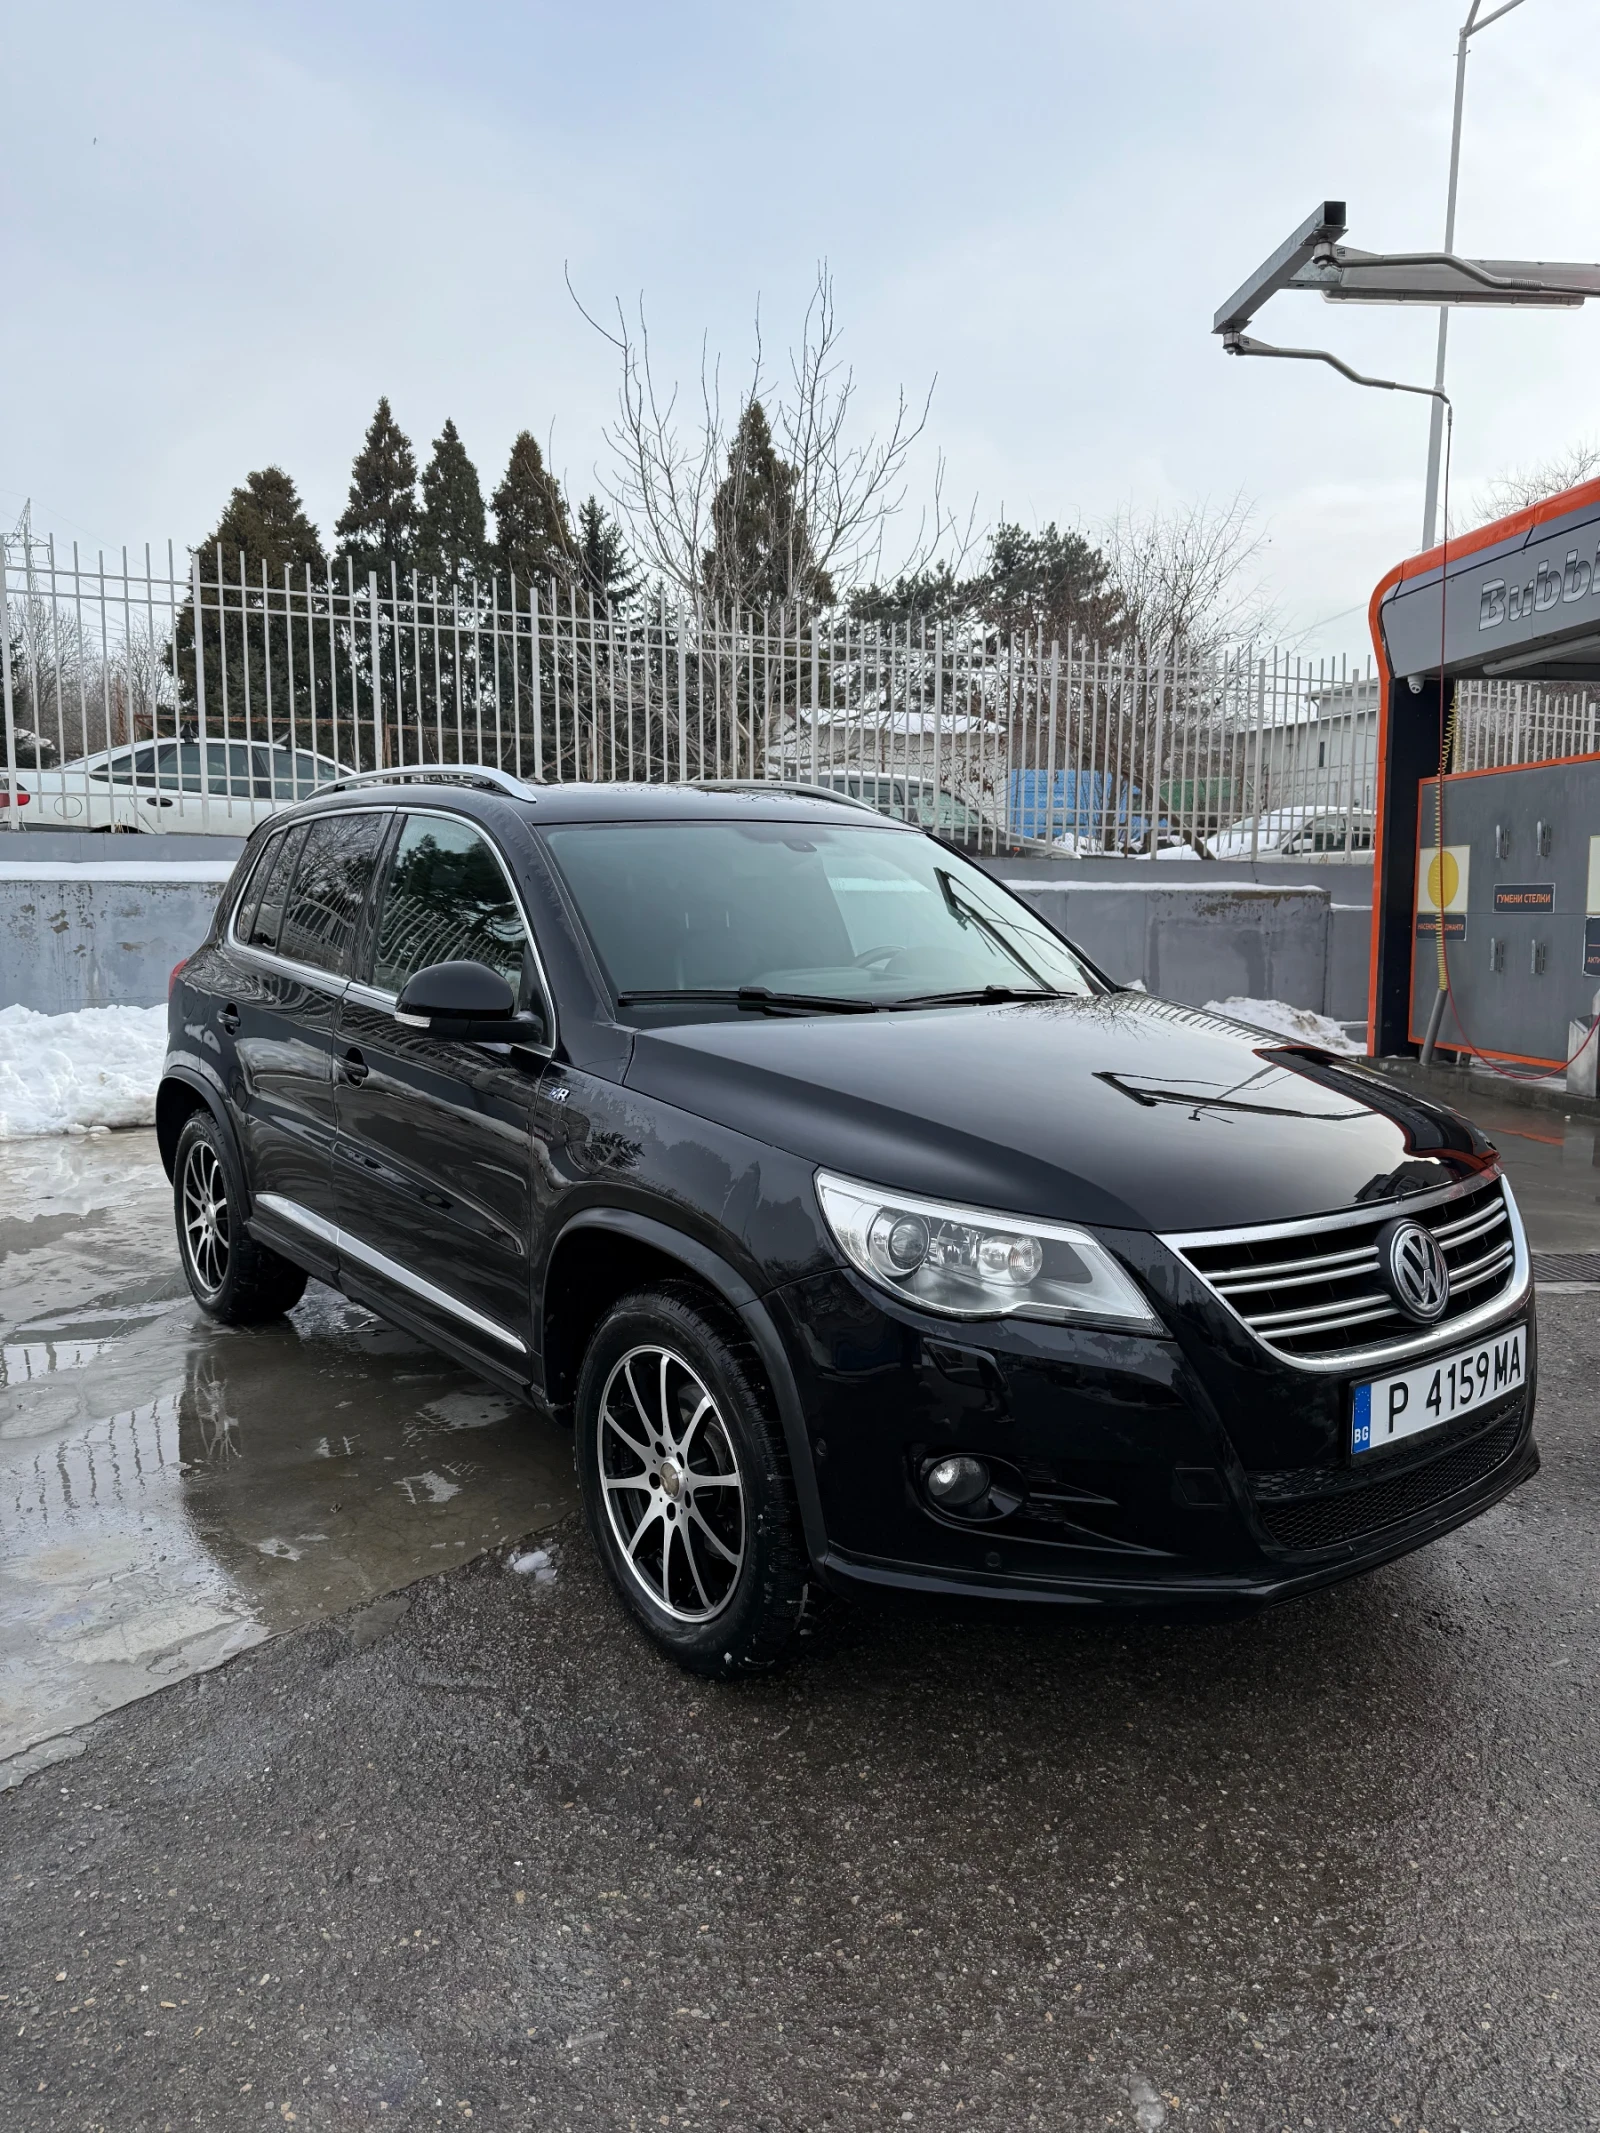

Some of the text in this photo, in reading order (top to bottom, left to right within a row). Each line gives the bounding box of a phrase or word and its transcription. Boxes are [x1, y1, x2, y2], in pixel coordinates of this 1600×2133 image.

[1496, 893, 1551, 903] ГУМЕНИ СТЕЛКИ
[1388, 1336, 1521, 1434] P 4159 MA
[1354, 1427, 1369, 1444] BG
